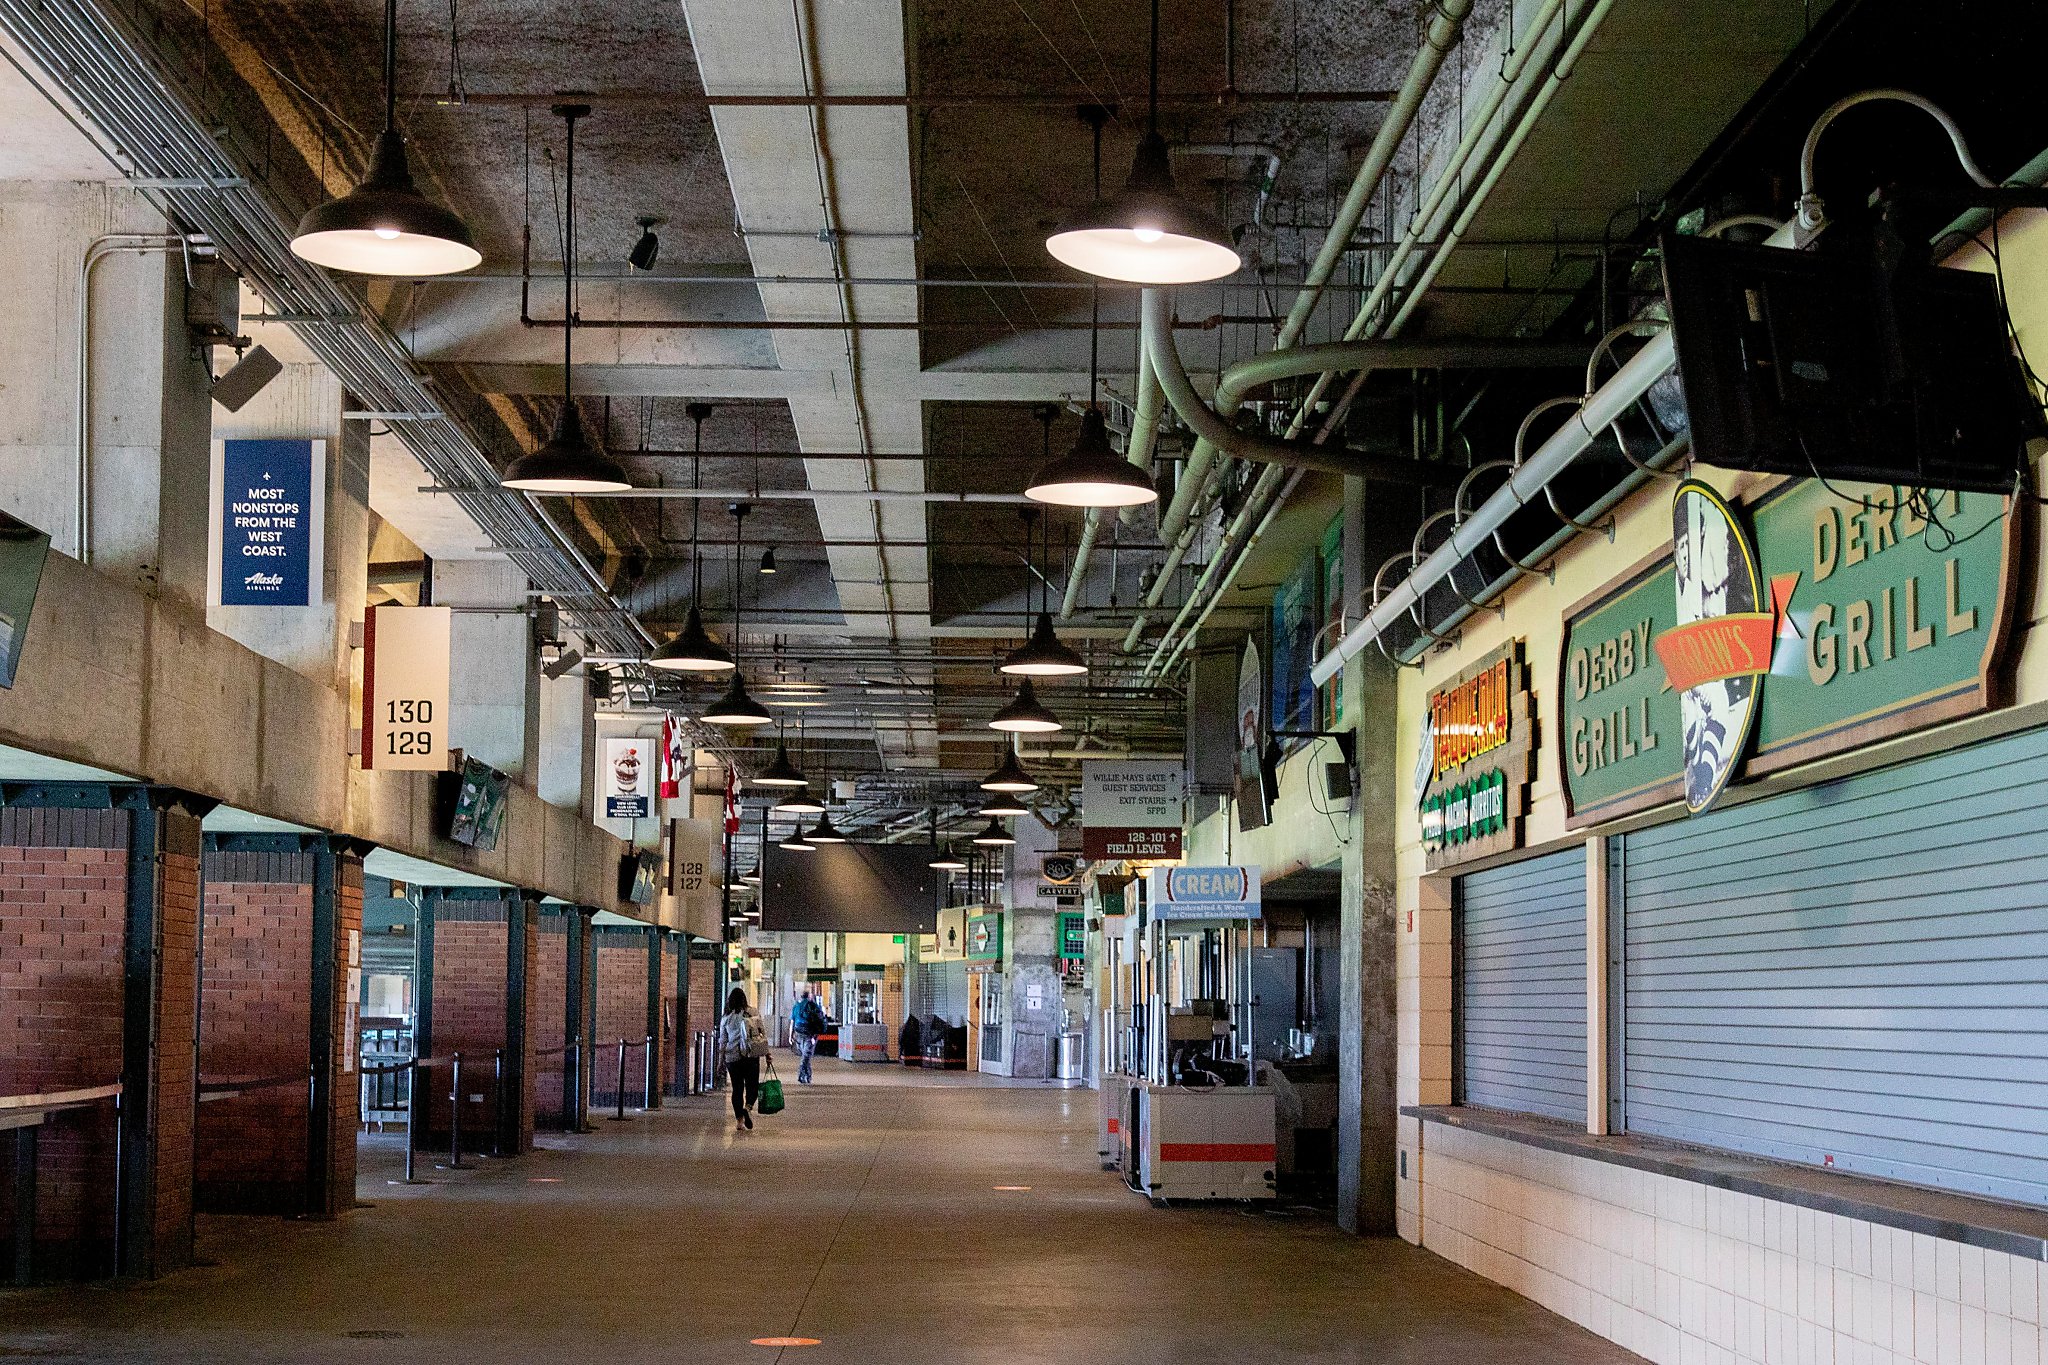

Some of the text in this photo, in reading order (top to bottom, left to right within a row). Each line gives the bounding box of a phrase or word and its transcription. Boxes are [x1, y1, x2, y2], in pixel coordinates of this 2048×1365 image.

[248, 488, 285, 500] MOST
[232, 502, 299, 514] NONSTOPS
[235, 517, 296, 528] FROM THE
[248, 531, 283, 542] WEST
[242, 545, 287, 557] COAST.
[244, 572, 284, 585] Alaska
[1807, 558, 1979, 687] GRILL
[1570, 616, 1653, 702] DERBY
[386, 700, 433, 724] 130
[1432, 658, 1508, 782] TAQUERIA
[386, 731, 432, 755] 129
[1572, 697, 1658, 778] GRILL
[1093, 773, 1166, 782] WILLIE MAYS GATE
[1102, 784, 1166, 792] GUEST SERVICES
[1120, 796, 1167, 805] EXIT STAIRS
[1470, 784, 1501, 823] BURRITOS
[1106, 844, 1167, 854] FIELD LEVEL
[681, 862, 703, 875] 128
[681, 878, 702, 890] 127
[1175, 874, 1239, 897] CREAM
[1040, 887, 1078, 896] CARVERY
